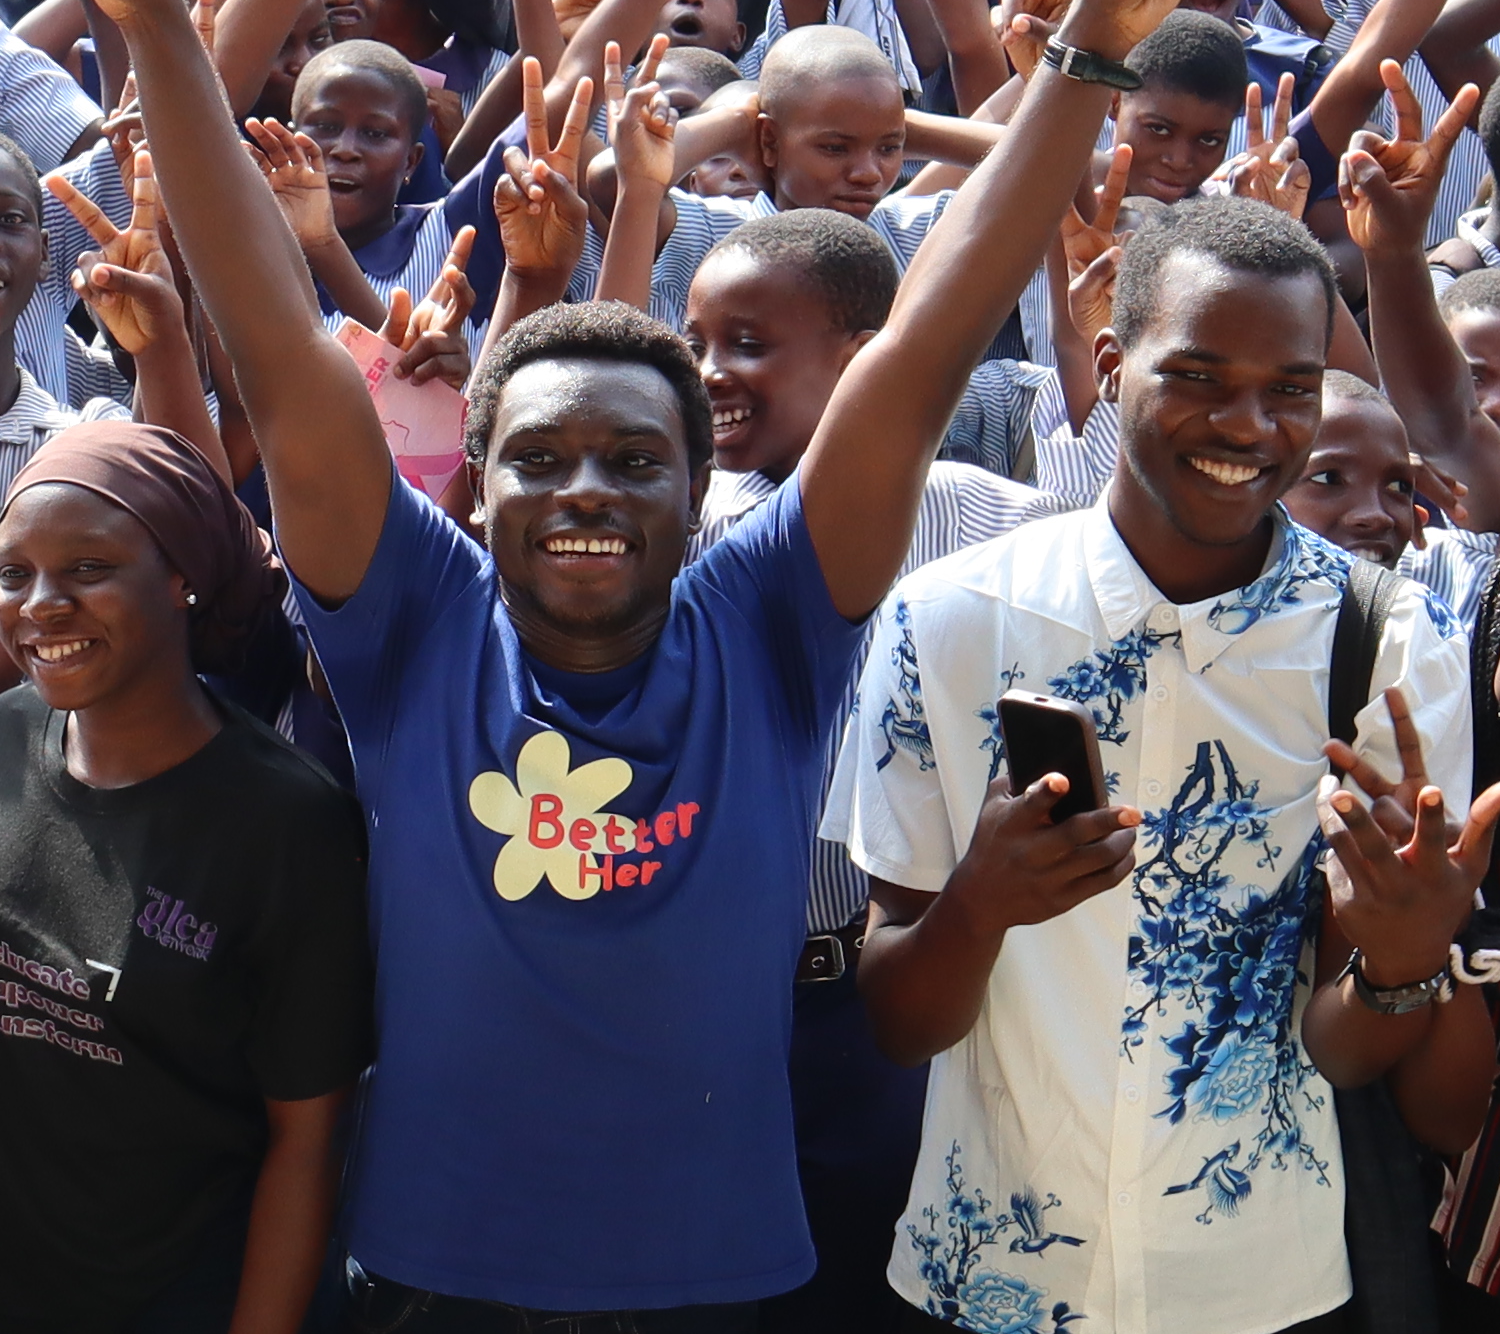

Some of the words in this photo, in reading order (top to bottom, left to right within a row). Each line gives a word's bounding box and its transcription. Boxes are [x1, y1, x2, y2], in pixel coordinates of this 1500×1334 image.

[528, 793, 700, 855] Better
[578, 853, 662, 891] Her
[146, 885, 164, 899] THE
[137, 894, 218, 950] glea
[155, 929, 209, 962] NETWORK
